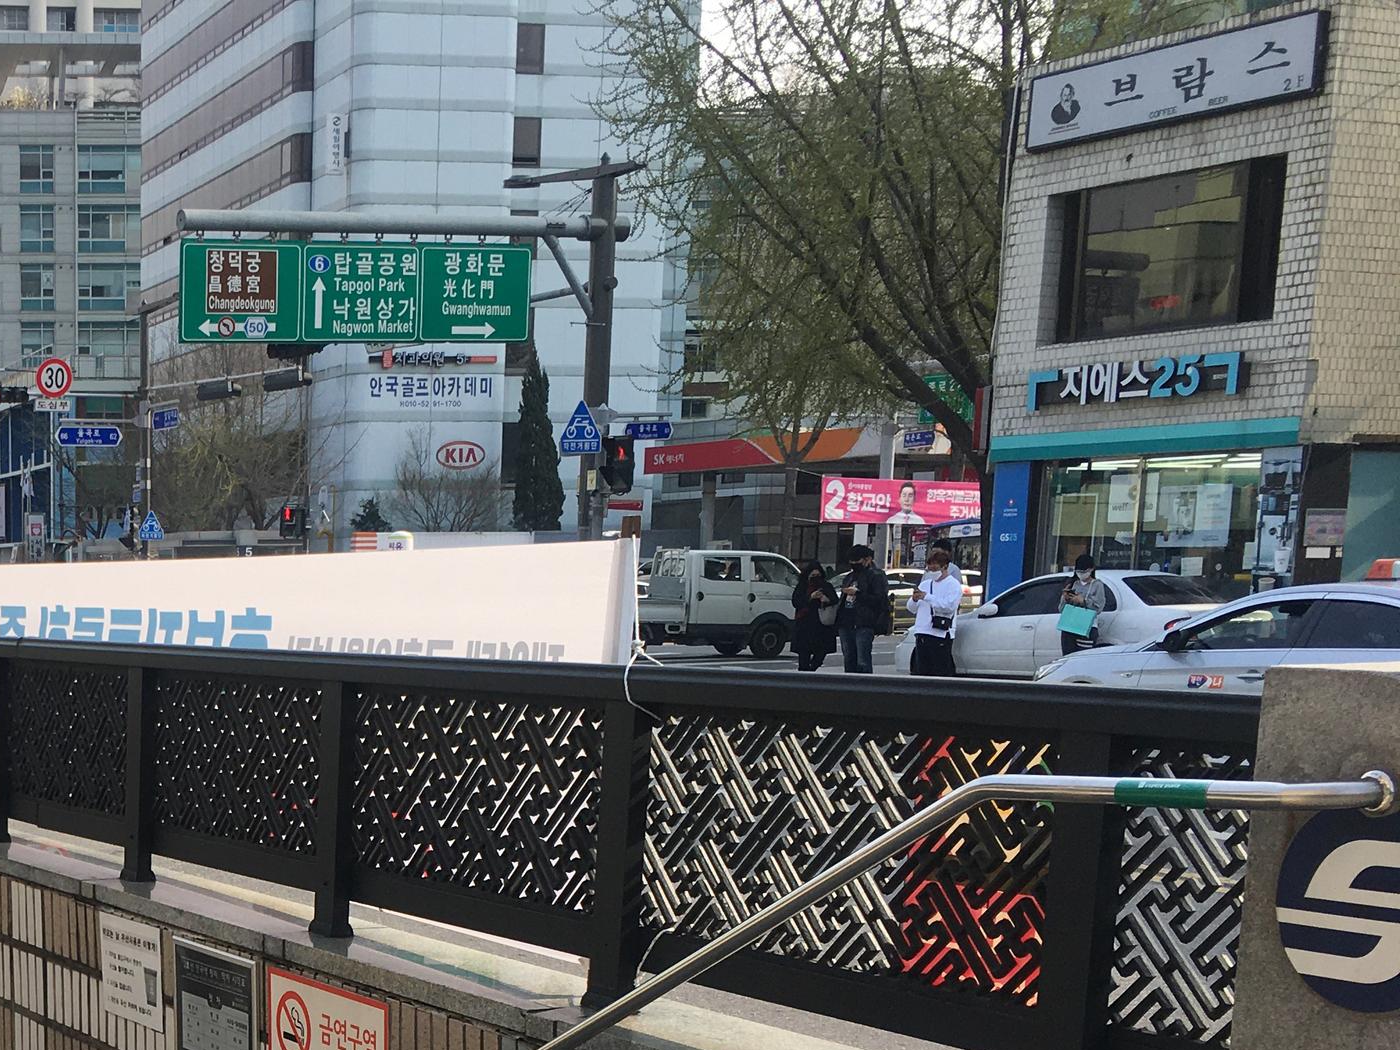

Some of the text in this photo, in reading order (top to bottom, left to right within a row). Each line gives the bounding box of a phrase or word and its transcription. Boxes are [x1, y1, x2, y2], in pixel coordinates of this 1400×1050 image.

[1104, 42, 1290, 107] 브람스
[1148, 95, 1228, 119] COFFEE BEER
[209, 250, 262, 273] 창덕궁
[315, 257, 324, 271] 6
[334, 252, 417, 276] 탑골공원
[444, 252, 505, 276] 광화문
[208, 275, 261, 294] 昌德宮
[334, 278, 405, 293] Tapgol Park
[443, 279, 495, 299] 光化門
[208, 295, 275, 314] Changdeokgung
[333, 297, 416, 321] 낙원상가
[442, 302, 511, 318] Gwanghwamun
[248, 321, 264, 333] 50
[333, 320, 413, 336] Nagwon Market
[44, 367, 65, 389] 30
[1059, 356, 1200, 406] 지에스25
[36, 401, 69, 411] 도심부
[445, 448, 477, 463] KIA
[653, 453, 665, 465] SK
[825, 480, 845, 519] 2
[846, 492, 892, 513] 황교안
